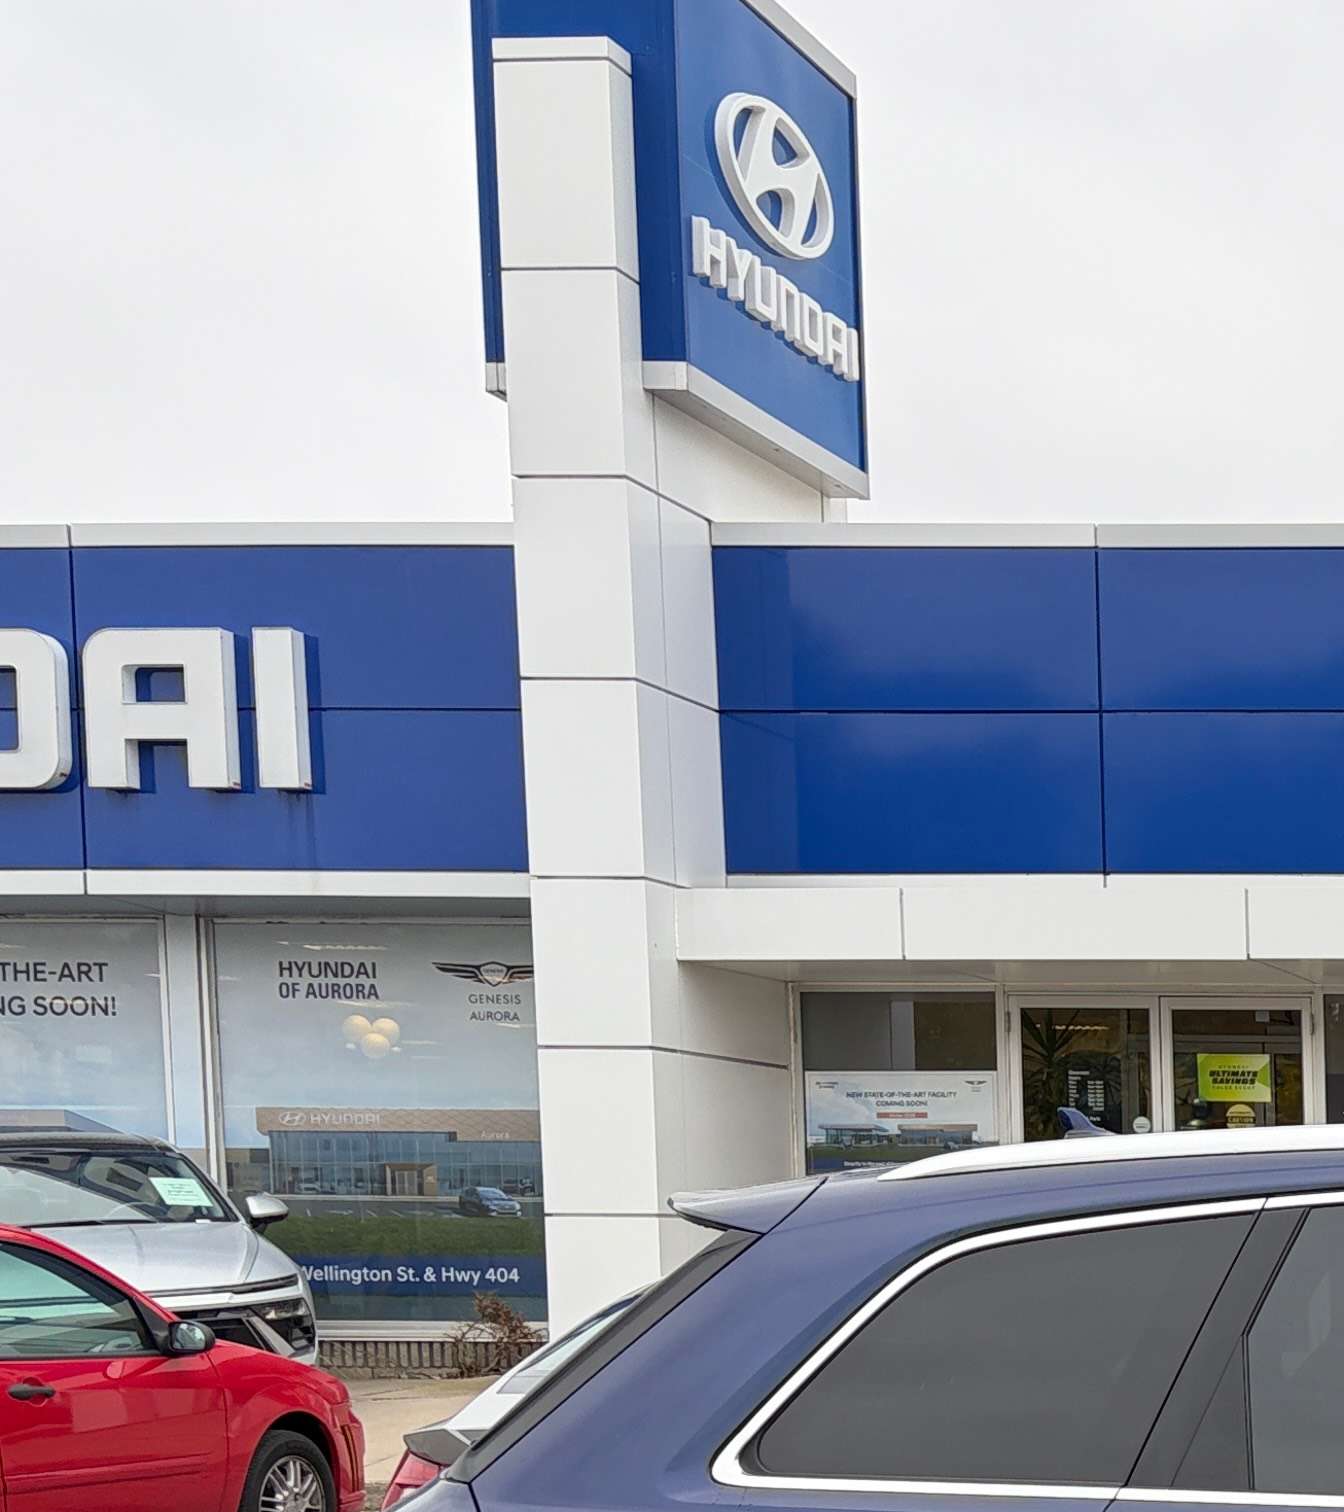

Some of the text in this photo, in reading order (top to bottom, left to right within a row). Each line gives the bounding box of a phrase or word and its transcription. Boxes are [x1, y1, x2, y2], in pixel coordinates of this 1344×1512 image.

[691, 214, 860, 382] HYUNDAI
[278, 960, 377, 979] HYUNDAI
[278, 981, 380, 1000] OF AURORA
[468, 993, 522, 1005] GENESIS
[33, 995, 117, 1017] SOON!
[470, 1010, 520, 1022] AURORA
[397, 1265, 420, 1283] St.
[423, 1266, 437, 1283] &
[441, 1266, 481, 1286] Hwy
[485, 1267, 520, 1283] 404
